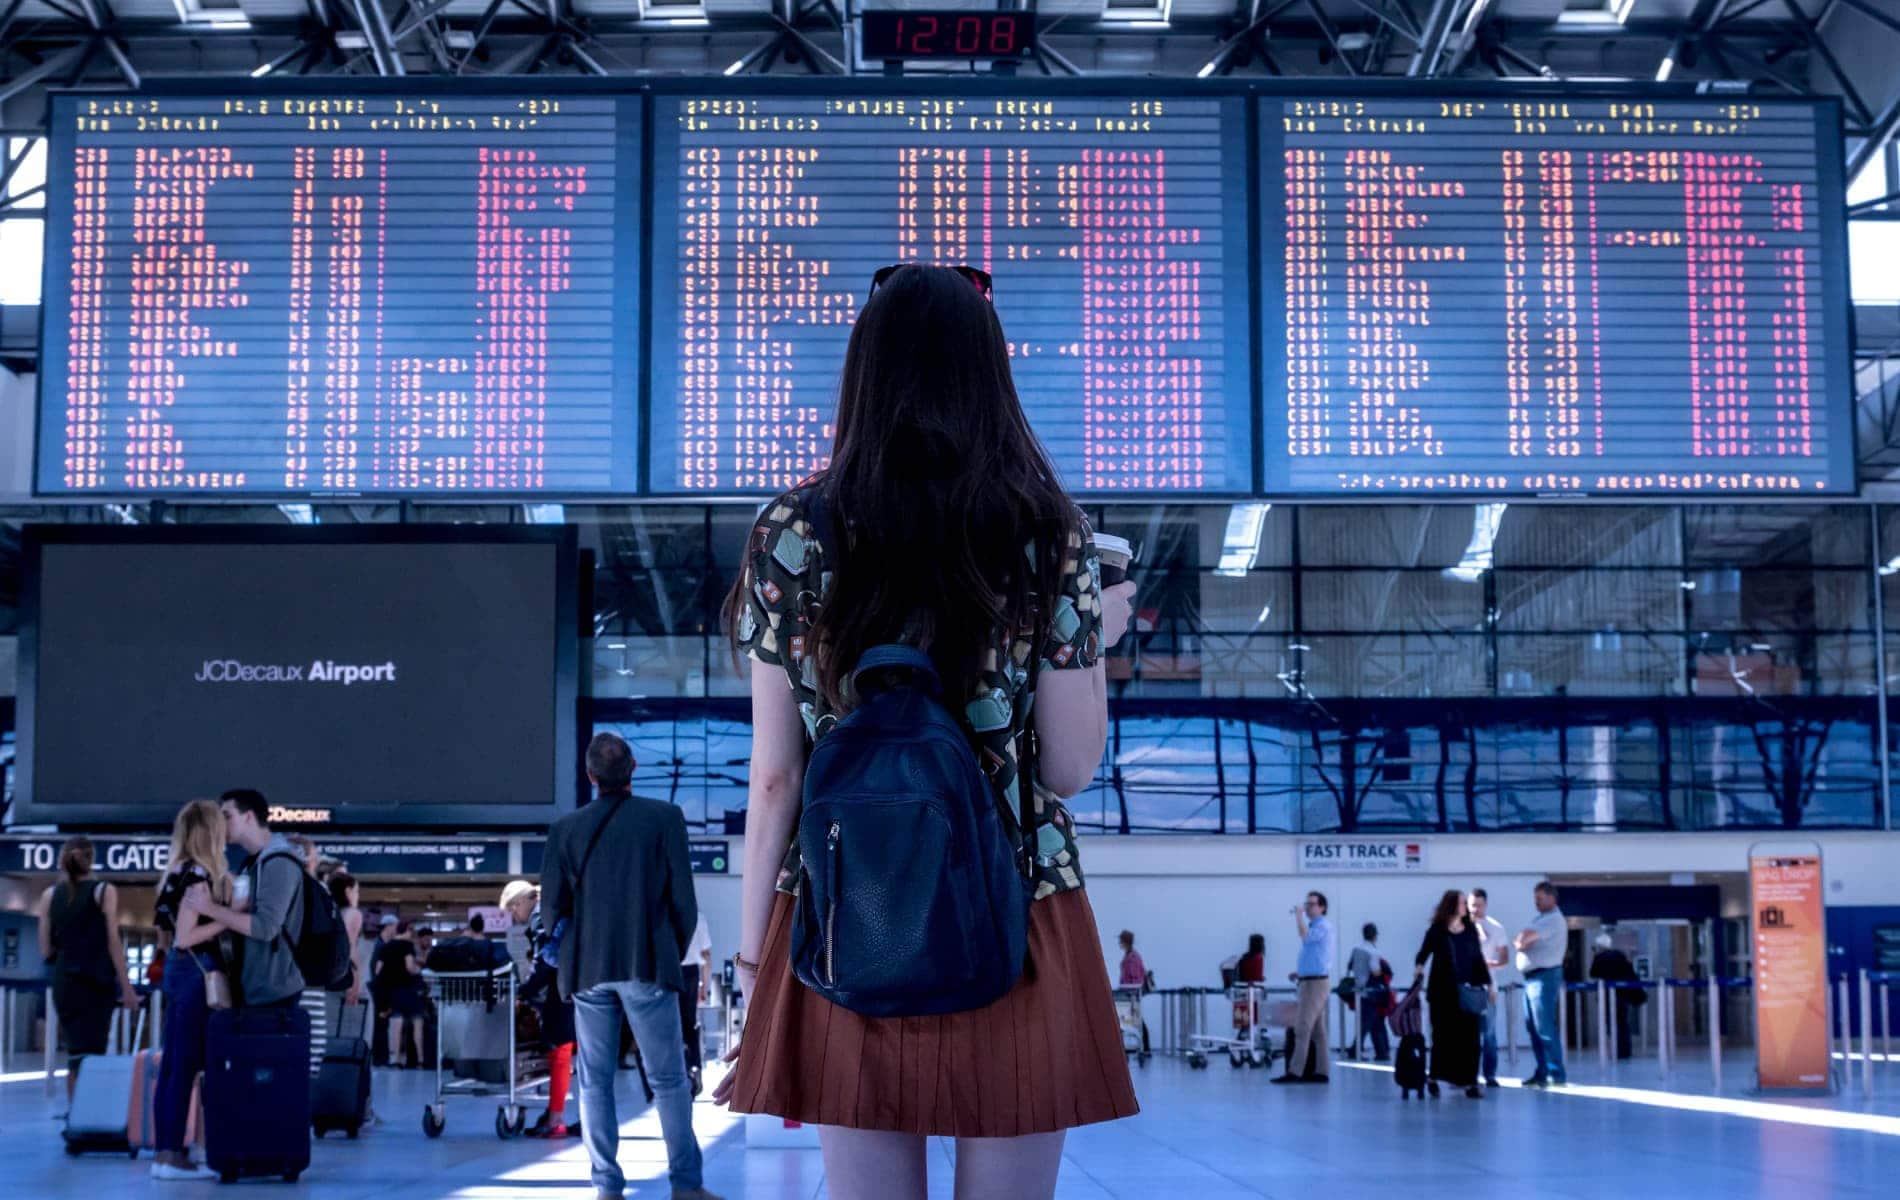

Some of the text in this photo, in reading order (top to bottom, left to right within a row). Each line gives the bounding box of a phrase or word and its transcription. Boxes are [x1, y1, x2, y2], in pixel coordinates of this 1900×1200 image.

[896, 16, 1016, 54] 12:08
[195, 660, 395, 685] JCDecaux Airport
[267, 805, 330, 822] Decaux
[18, 843, 54, 870] TO
[106, 843, 170, 870] GATE
[1305, 844, 1397, 858] FAST TRACK
